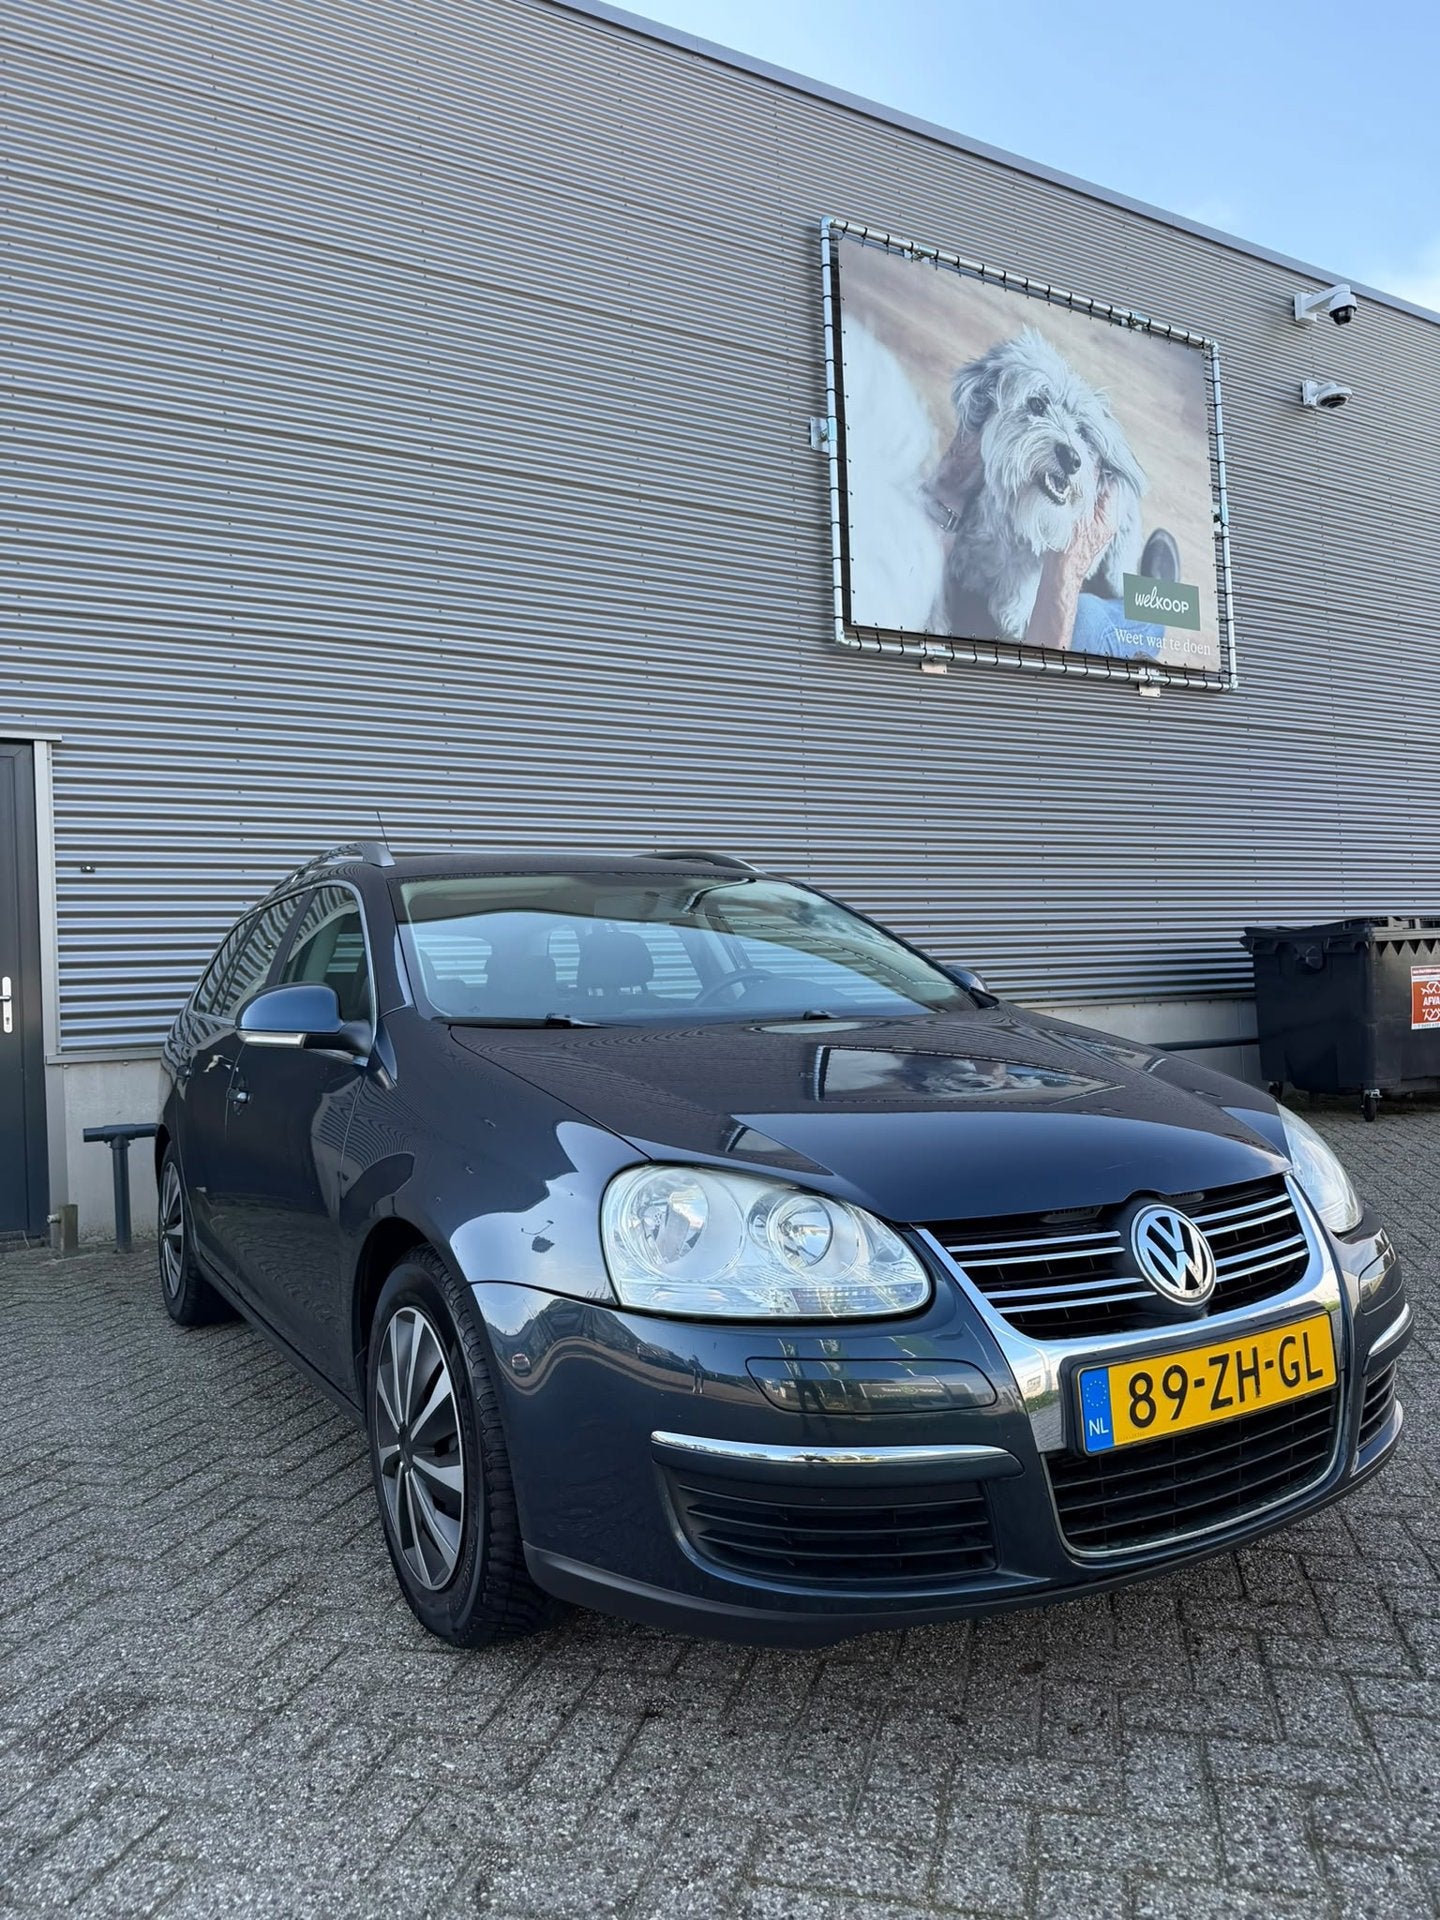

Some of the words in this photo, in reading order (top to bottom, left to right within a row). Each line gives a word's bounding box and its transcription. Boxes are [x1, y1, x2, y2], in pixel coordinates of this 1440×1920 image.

[1115, 628, 1143, 646] Weet
[1146, 634, 1166, 649] wat
[1169, 638, 1181, 651] te
[1183, 639, 1211, 656] doen
[1128, 1332, 1324, 1429] 89-ZH-GL
[1088, 1418, 1109, 1437] NL
